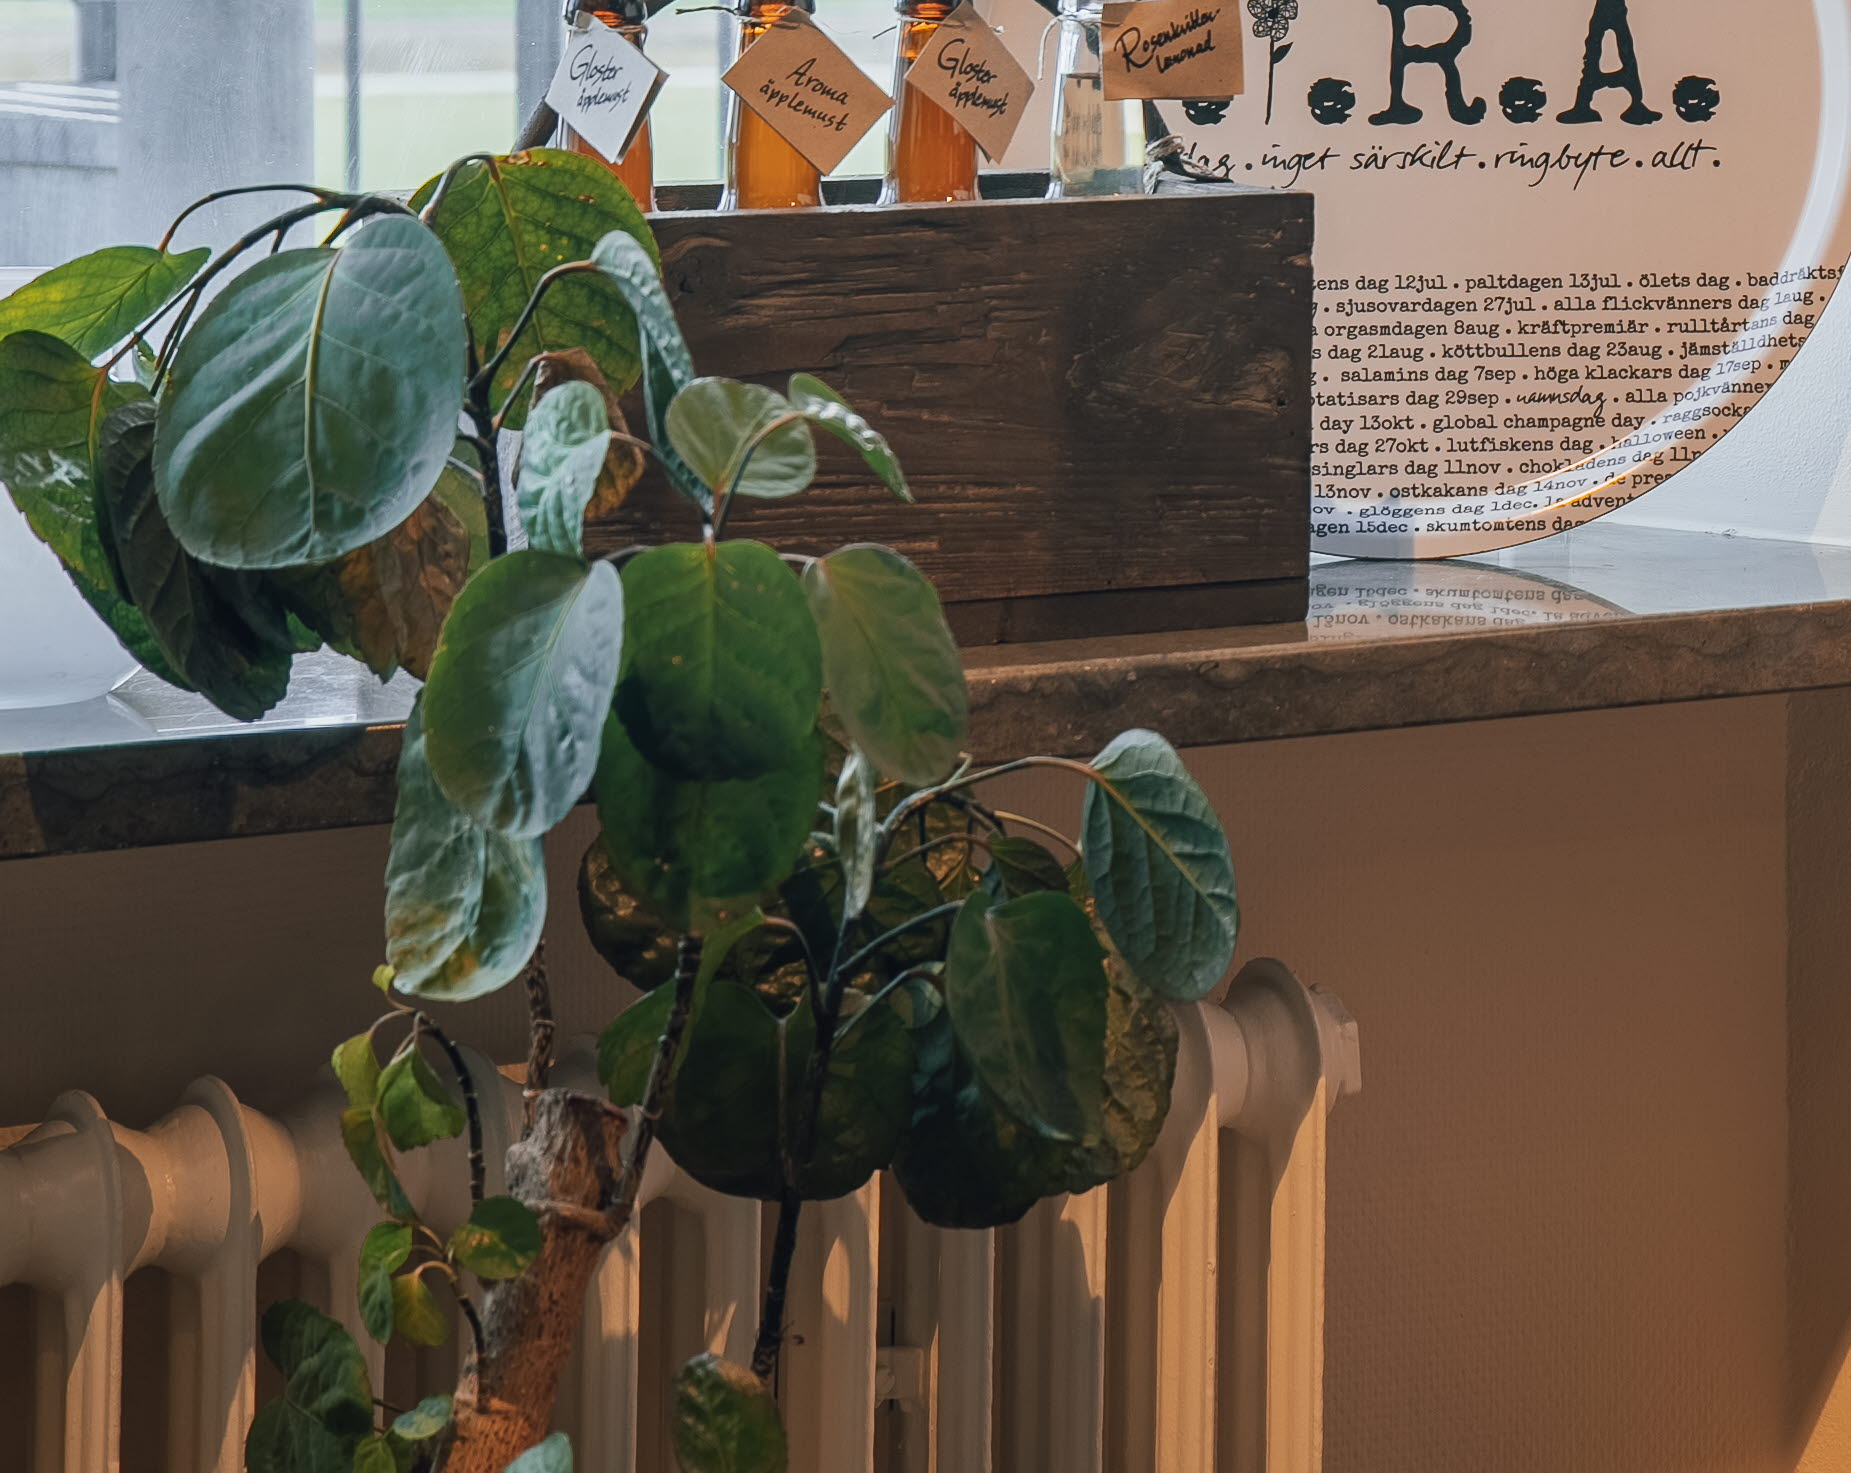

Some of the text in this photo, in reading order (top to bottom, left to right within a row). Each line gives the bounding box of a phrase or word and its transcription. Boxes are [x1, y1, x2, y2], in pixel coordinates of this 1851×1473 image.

[785, 57, 849, 105] Aroma
[760, 78, 850, 132] äpplemust
[1354, 275, 1390, 295] dag
[1464, 273, 1564, 294] paltdagen
[1638, 272, 1691, 289] ölets
[1695, 271, 1731, 292] dag
[1323, 320, 1449, 341] orgasmdagen
[1453, 319, 1501, 339] 8aug
[1516, 318, 1650, 339] kräftpremiär
[1782, 310, 1819, 332] dag
[1340, 366, 1430, 383] salamins
[1434, 365, 1469, 386] dag
[1473, 364, 1517, 385] 7sep
[1533, 365, 1581, 385] höga
[1584, 364, 1673, 381] klackars
[1677, 363, 1712, 382] dag
